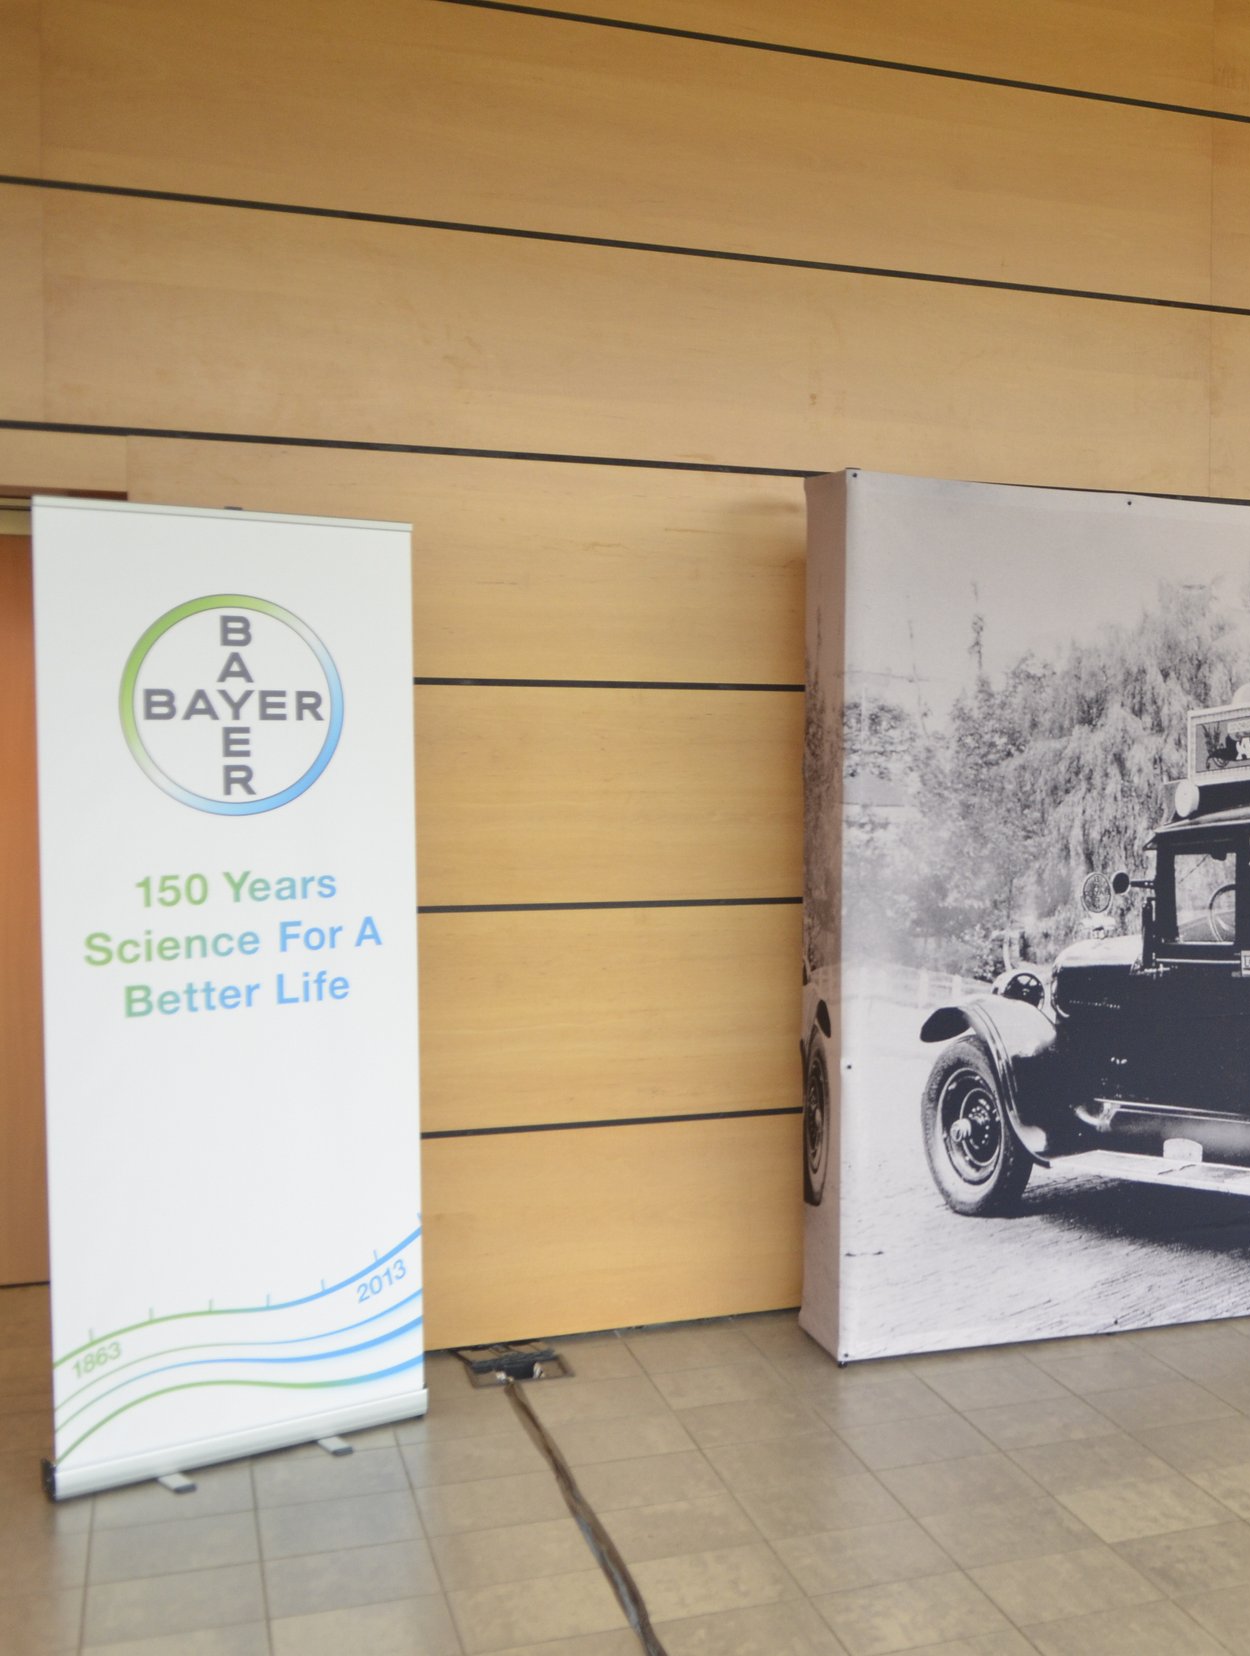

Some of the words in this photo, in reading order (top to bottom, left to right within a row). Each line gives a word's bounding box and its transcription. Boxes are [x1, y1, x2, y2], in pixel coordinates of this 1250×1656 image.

[143, 689, 324, 721] BAYER
[217, 615, 256, 795] BAYER
[136, 874, 209, 907] 150
[224, 871, 337, 903] Years
[84, 928, 260, 967] Science
[278, 920, 342, 952] For
[354, 917, 383, 947] A
[124, 980, 260, 1018] Better
[276, 973, 350, 1004] Life
[357, 1259, 407, 1303] 2013
[73, 1341, 122, 1378] 1863
